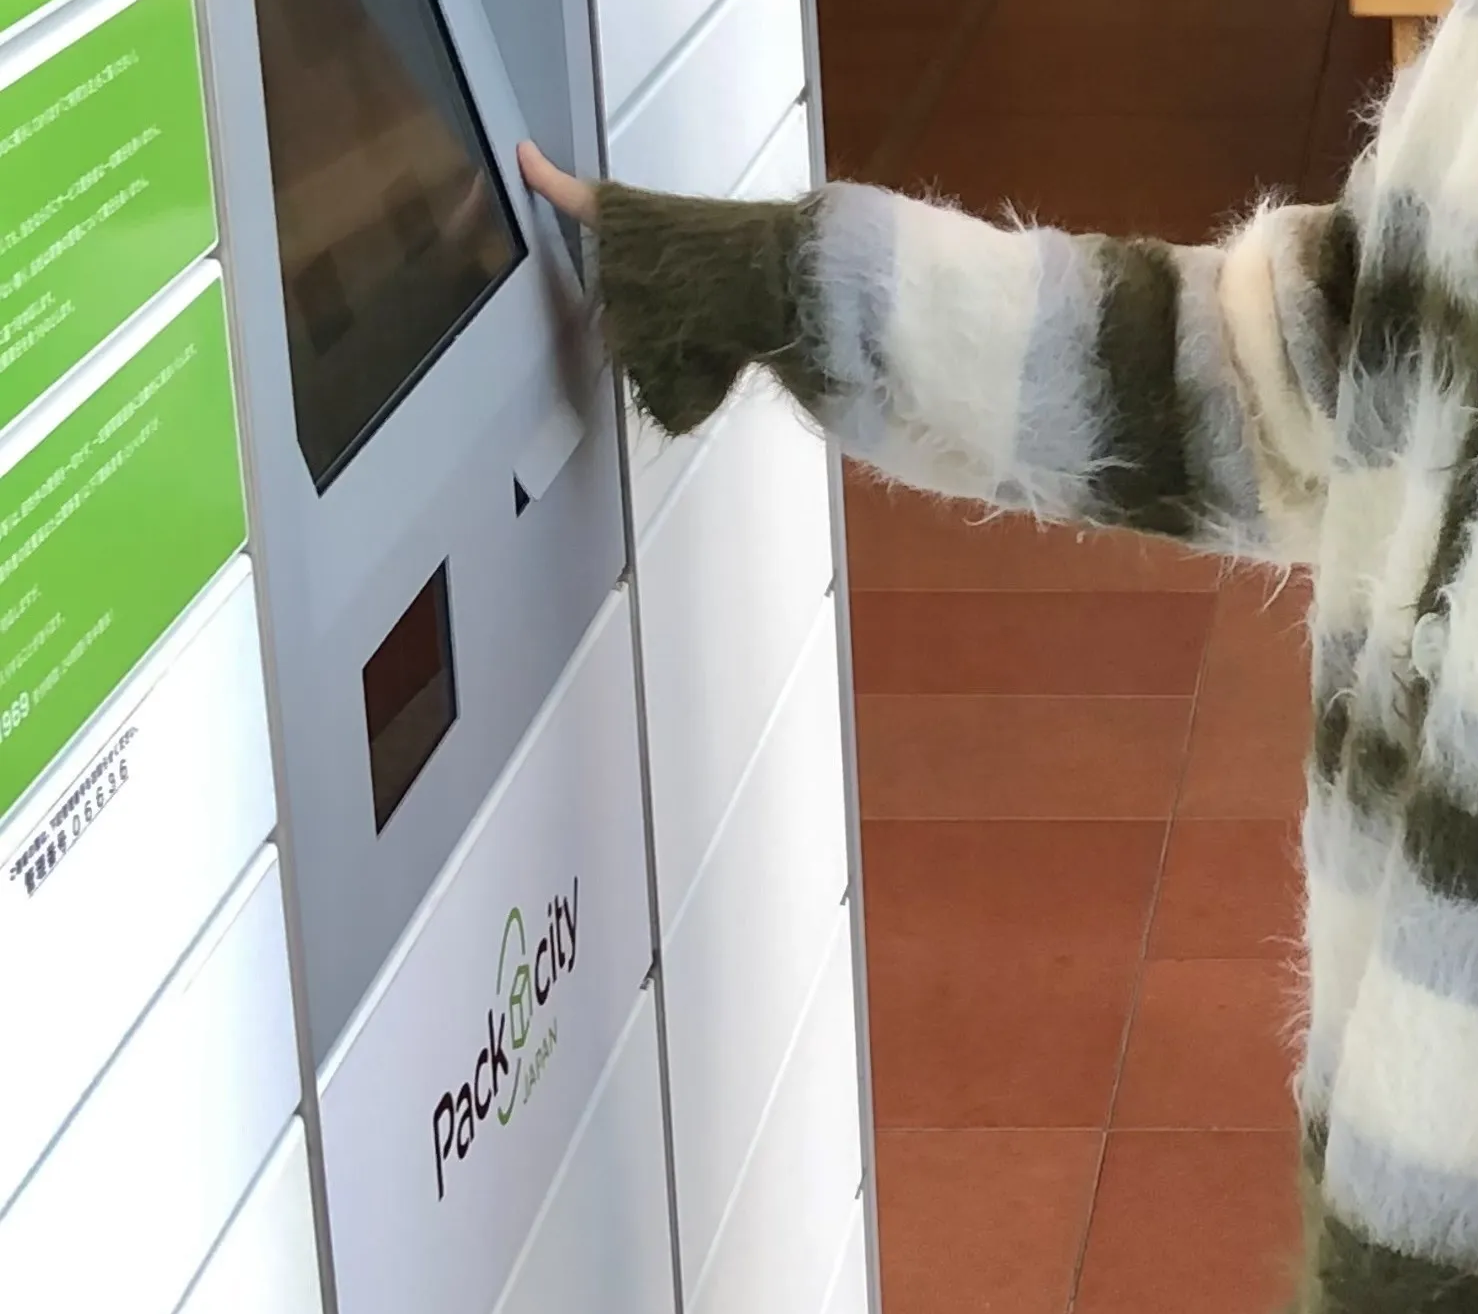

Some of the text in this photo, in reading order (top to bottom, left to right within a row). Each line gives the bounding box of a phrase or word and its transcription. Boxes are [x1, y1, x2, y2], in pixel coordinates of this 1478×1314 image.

[0, 691, 30, 745] 969
[433, 876, 579, 1202] Pack city
[523, 1016, 558, 1105] JAPAN
